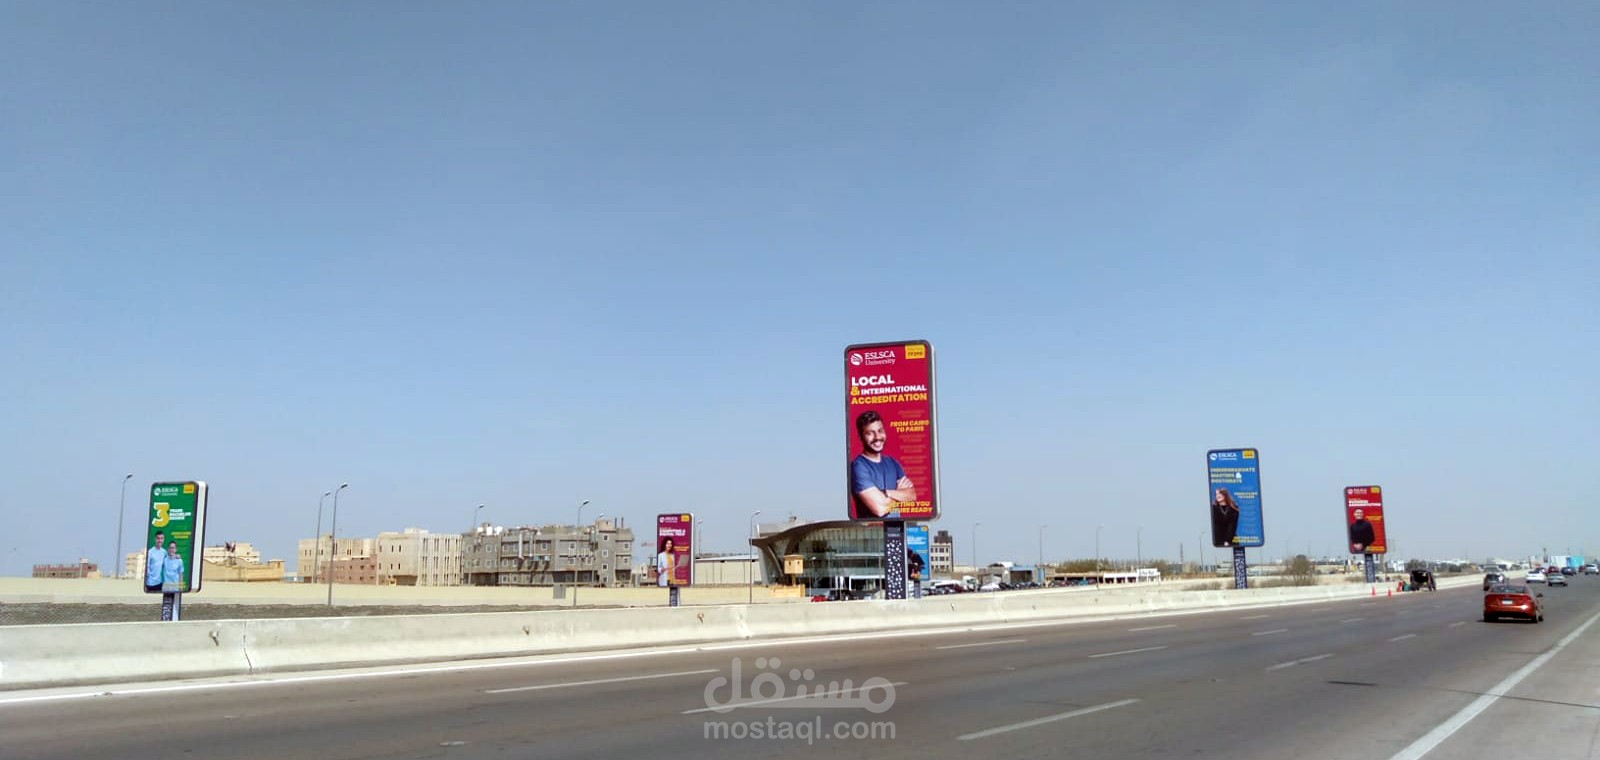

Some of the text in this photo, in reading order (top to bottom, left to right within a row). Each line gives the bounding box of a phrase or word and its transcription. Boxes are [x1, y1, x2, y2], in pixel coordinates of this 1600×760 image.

[865, 350, 895, 360] ESLSCA
[851, 374, 895, 386] LOCAL
[851, 384, 927, 396] & INTERNATIONAL
[851, 393, 928, 404] ACCREDITATION
[152, 502, 170, 527] 3
